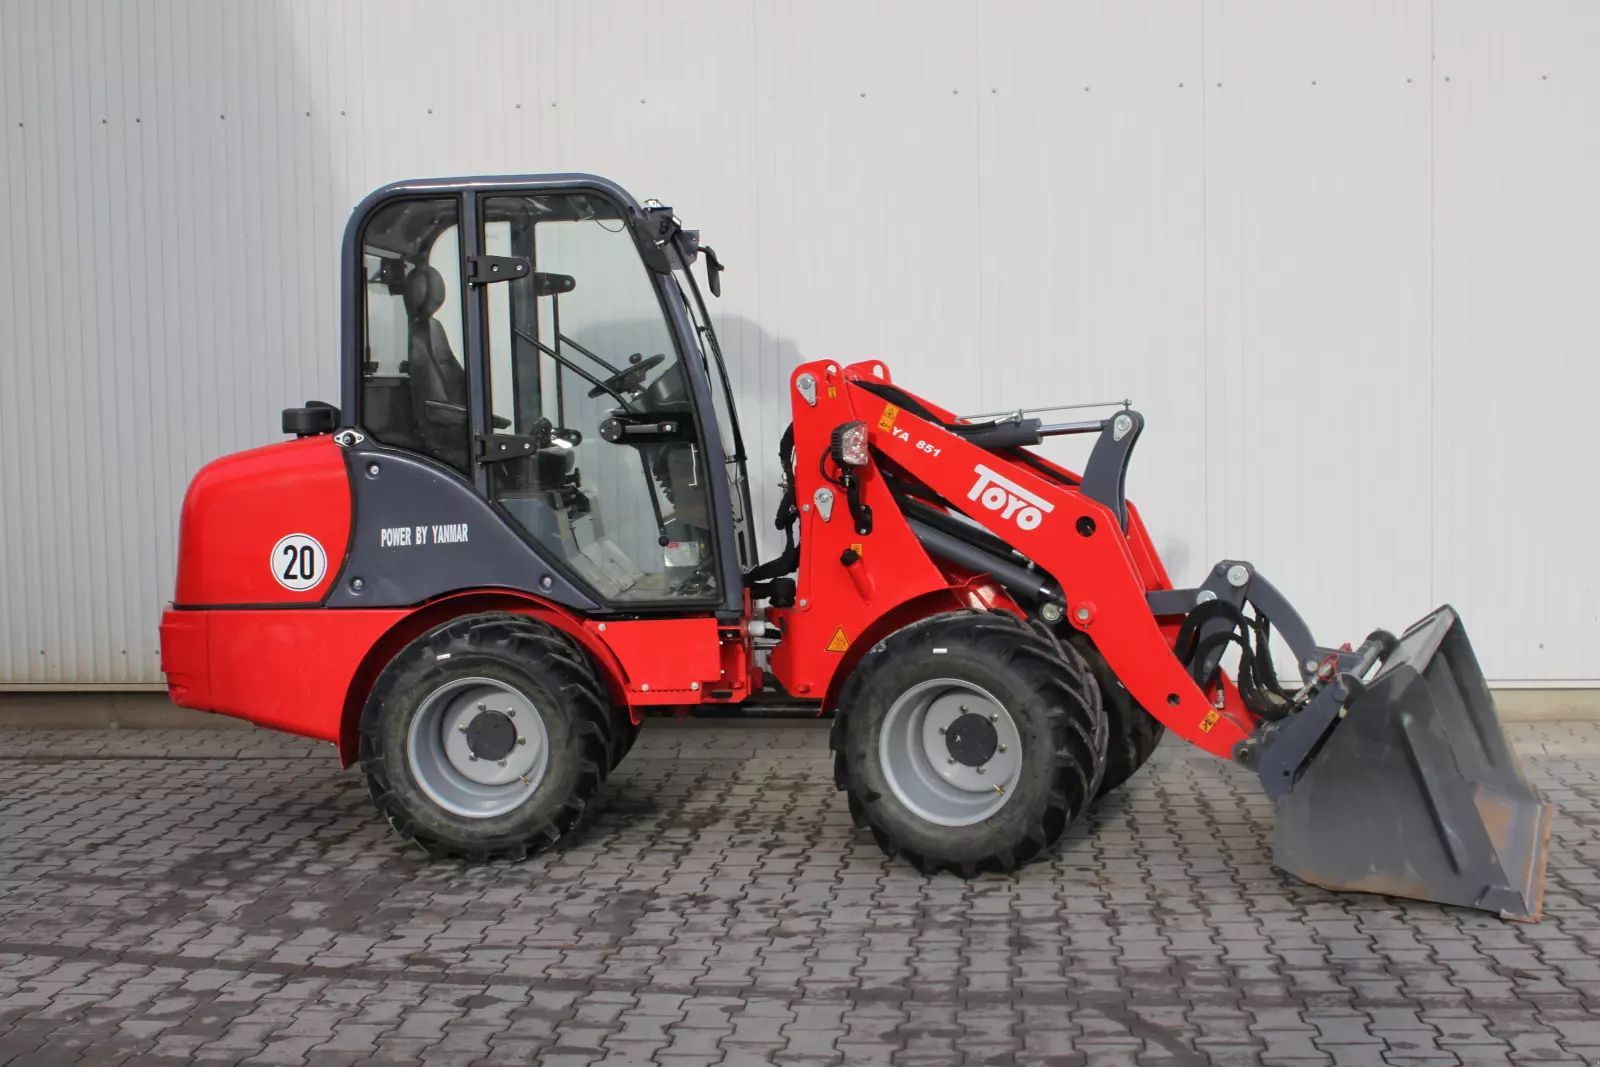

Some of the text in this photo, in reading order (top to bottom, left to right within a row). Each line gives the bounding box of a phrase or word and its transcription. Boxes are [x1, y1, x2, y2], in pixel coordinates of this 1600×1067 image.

[891, 426, 941, 457] YA 851
[381, 524, 468, 547] POWER BY YANMAR
[283, 545, 314, 580] 20
